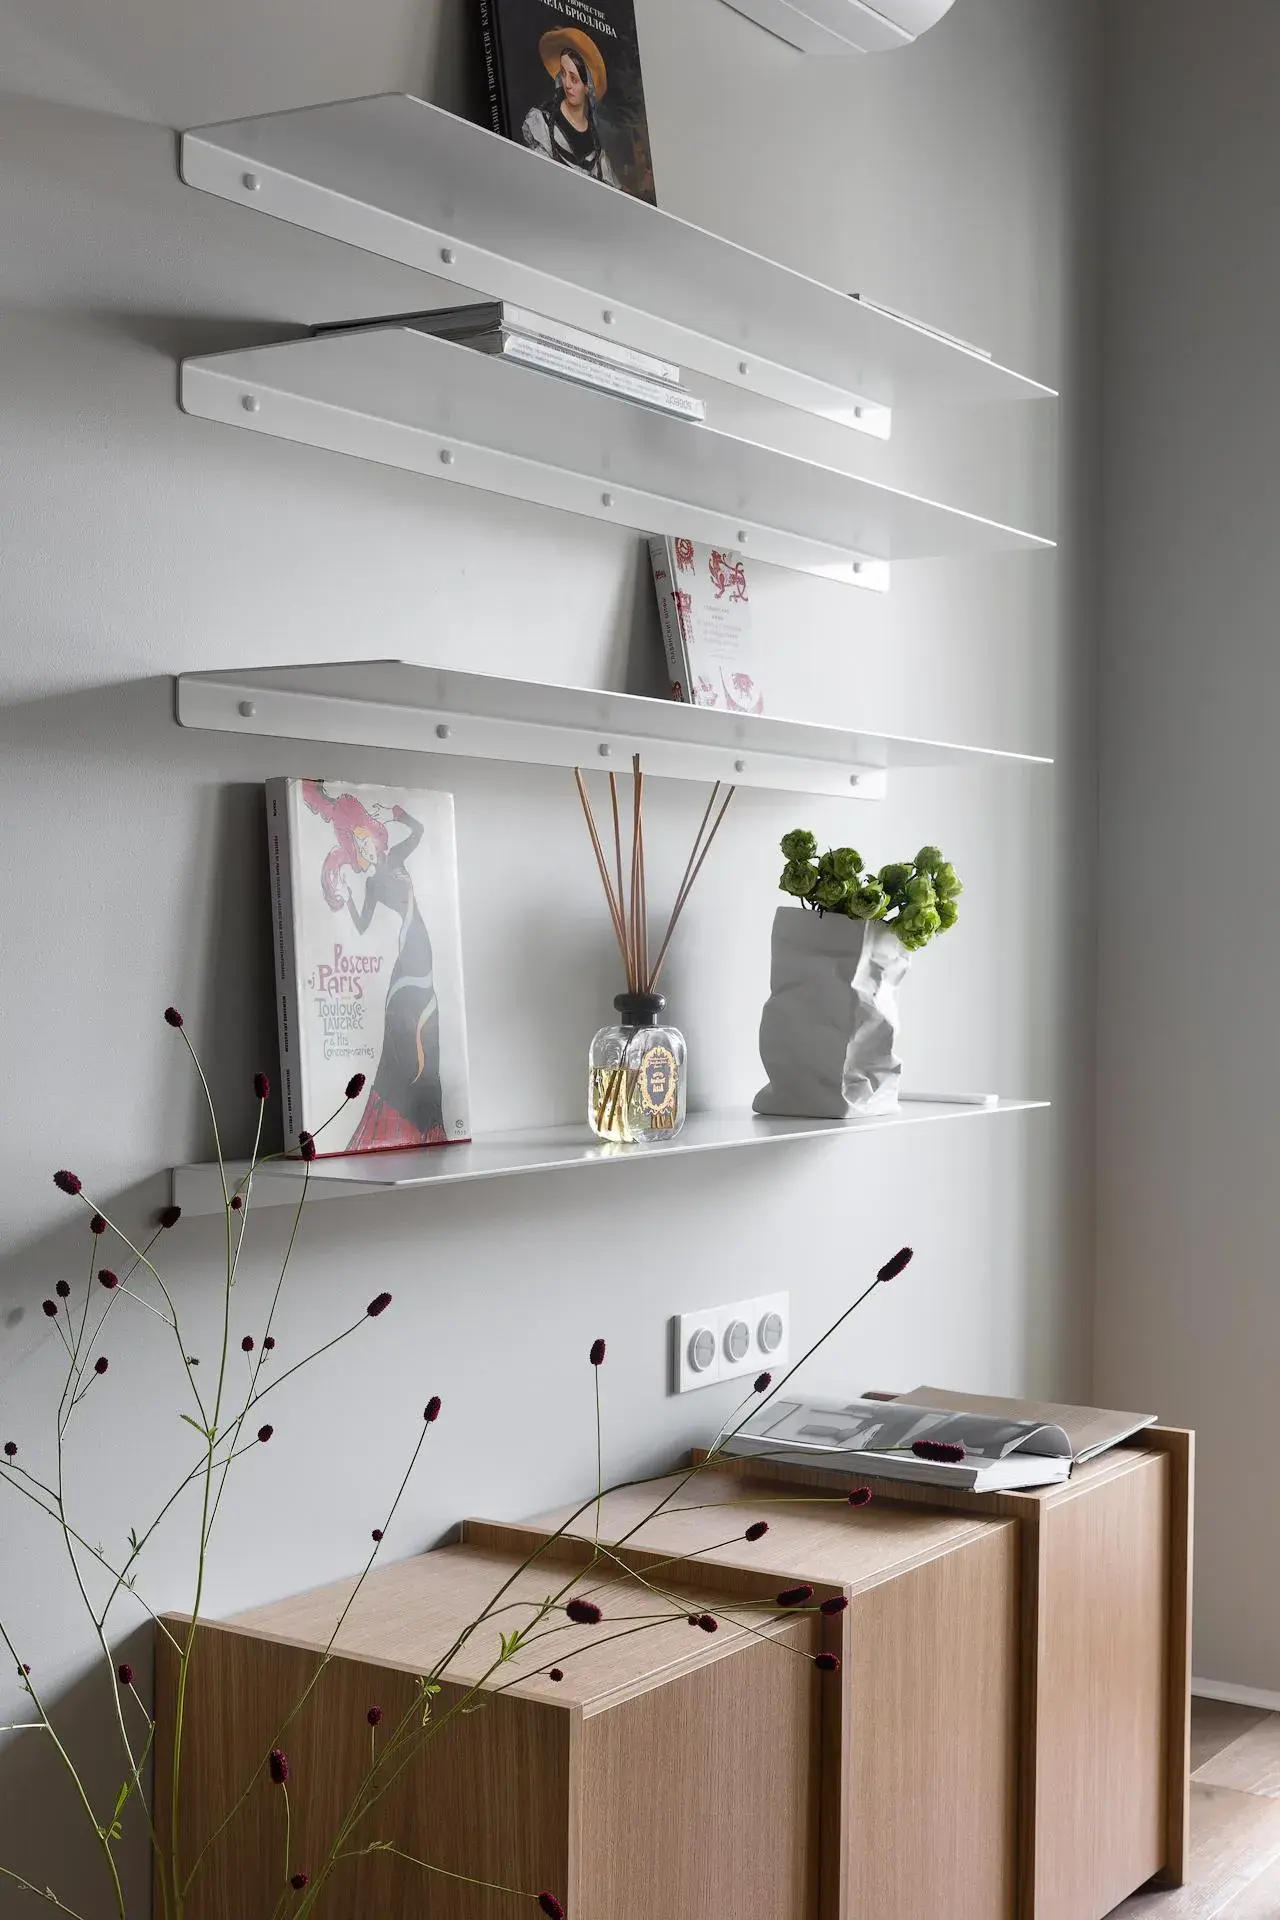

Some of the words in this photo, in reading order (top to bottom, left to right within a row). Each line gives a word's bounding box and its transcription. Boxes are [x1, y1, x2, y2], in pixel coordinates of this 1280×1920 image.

[564, 4, 618, 39] БРЮЛЛОВА
[483, 31, 496, 91] ТВОРЧЕСТВЕ
[333, 943, 384, 975] Posters
[336, 1031, 349, 1046] His
